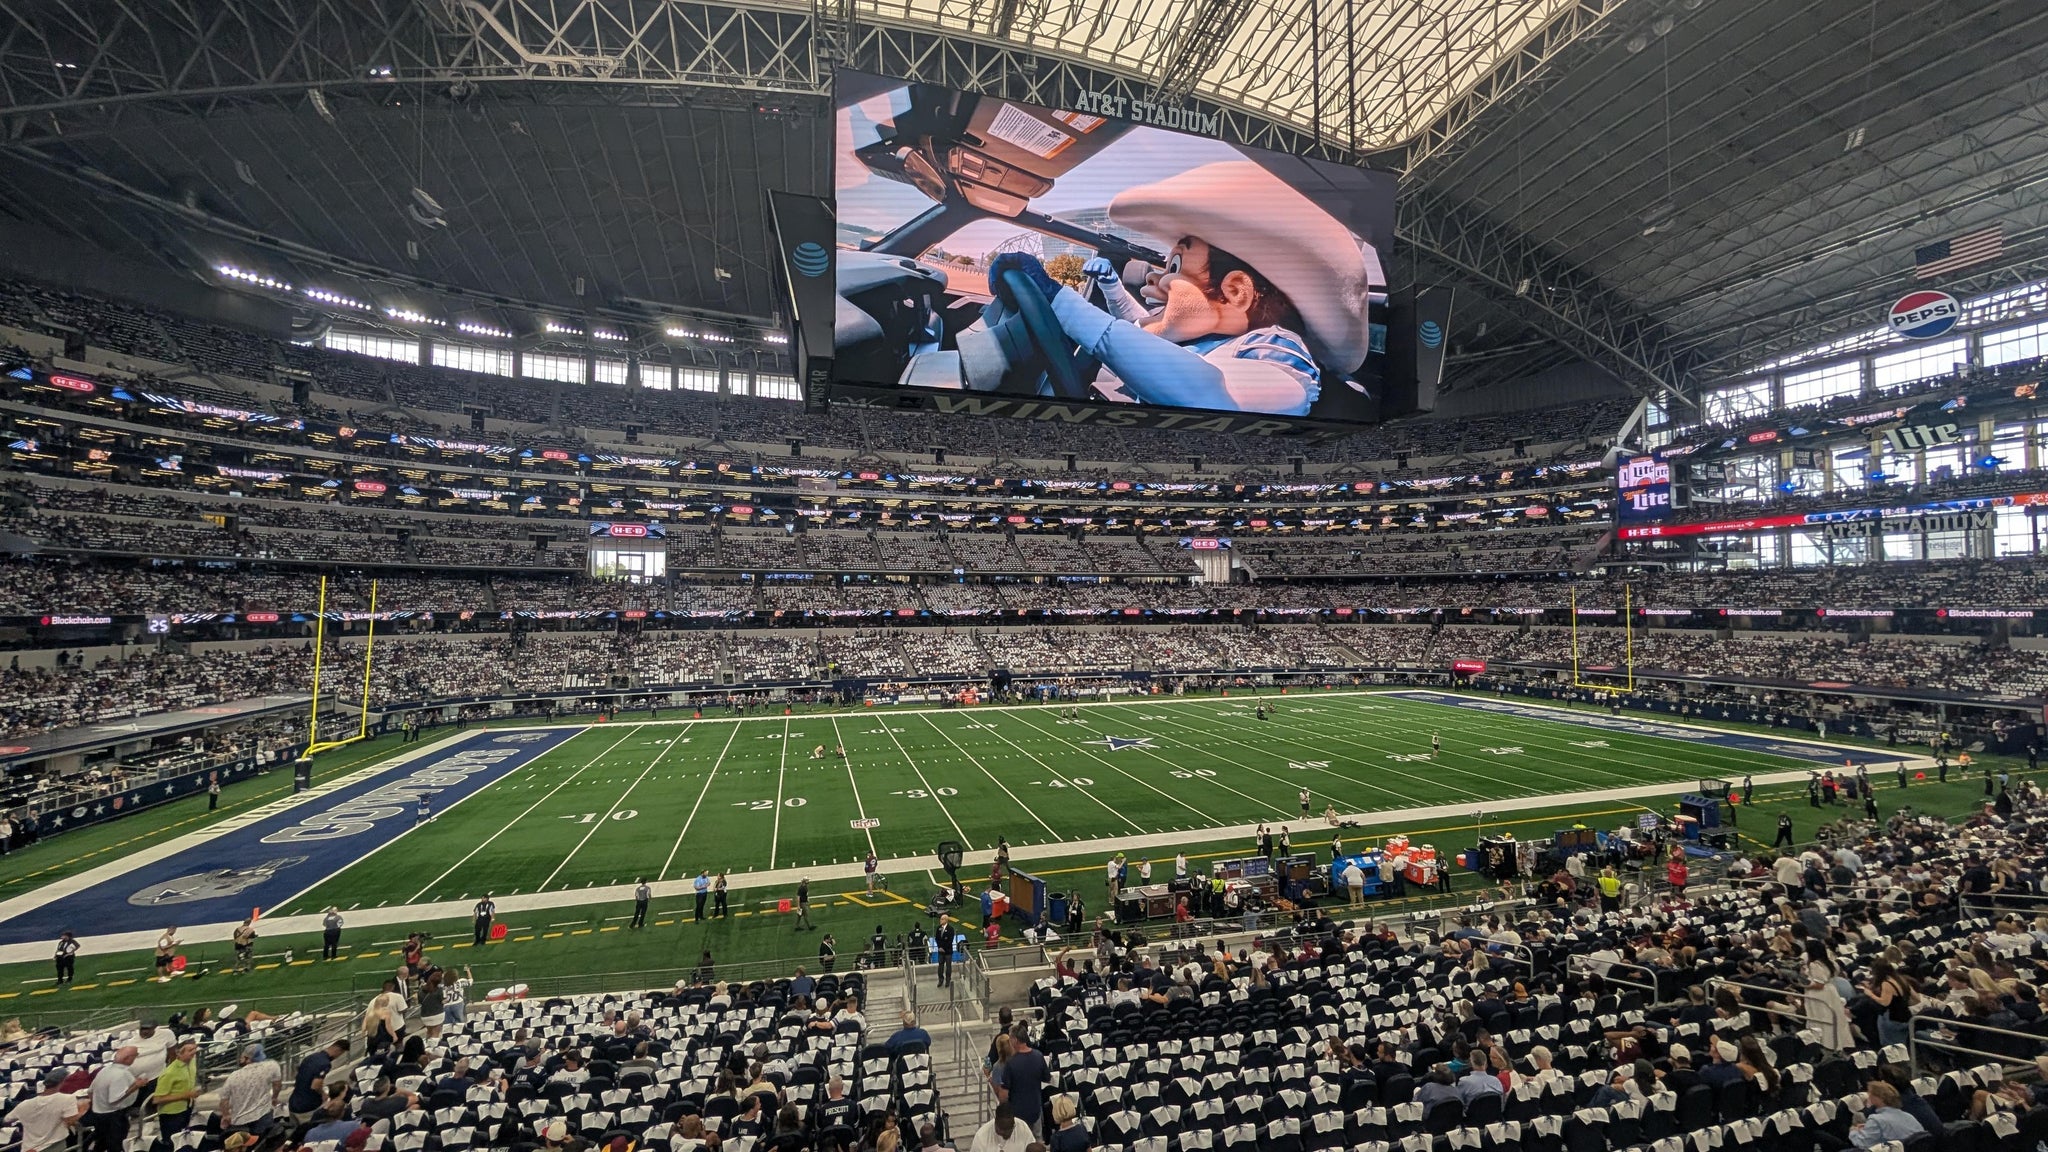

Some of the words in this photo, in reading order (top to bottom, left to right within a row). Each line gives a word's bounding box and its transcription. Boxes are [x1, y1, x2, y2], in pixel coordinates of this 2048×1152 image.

[1075, 89, 1127, 118] AT&T
[1131, 99, 1218, 136] STADIUM
[1893, 302, 1956, 327] PEPSI
[932, 395, 1293, 437] WINSTAR
[1881, 423, 1960, 454] Lite
[1632, 493, 1669, 510] Lite
[1824, 521, 1875, 539] AT&T
[1881, 511, 1993, 533] STADIUM
[1726, 608, 1782, 616] Blockchain.com
[1825, 609, 1894, 617] Blockchain.com
[1948, 609, 2034, 618] Blockchain.com
[50, 615, 111, 625] Blockchain.com
[150, 619, 168, 632] 25
[1169, 769, 1217, 779] 50
[1047, 776, 1094, 789] 40
[260, 748, 521, 843] COWBOYS
[905, 786, 960, 799] 30
[750, 797, 808, 811] 20
[574, 809, 639, 824] 10
[825, 1105, 849, 1116] PRESCOTT
